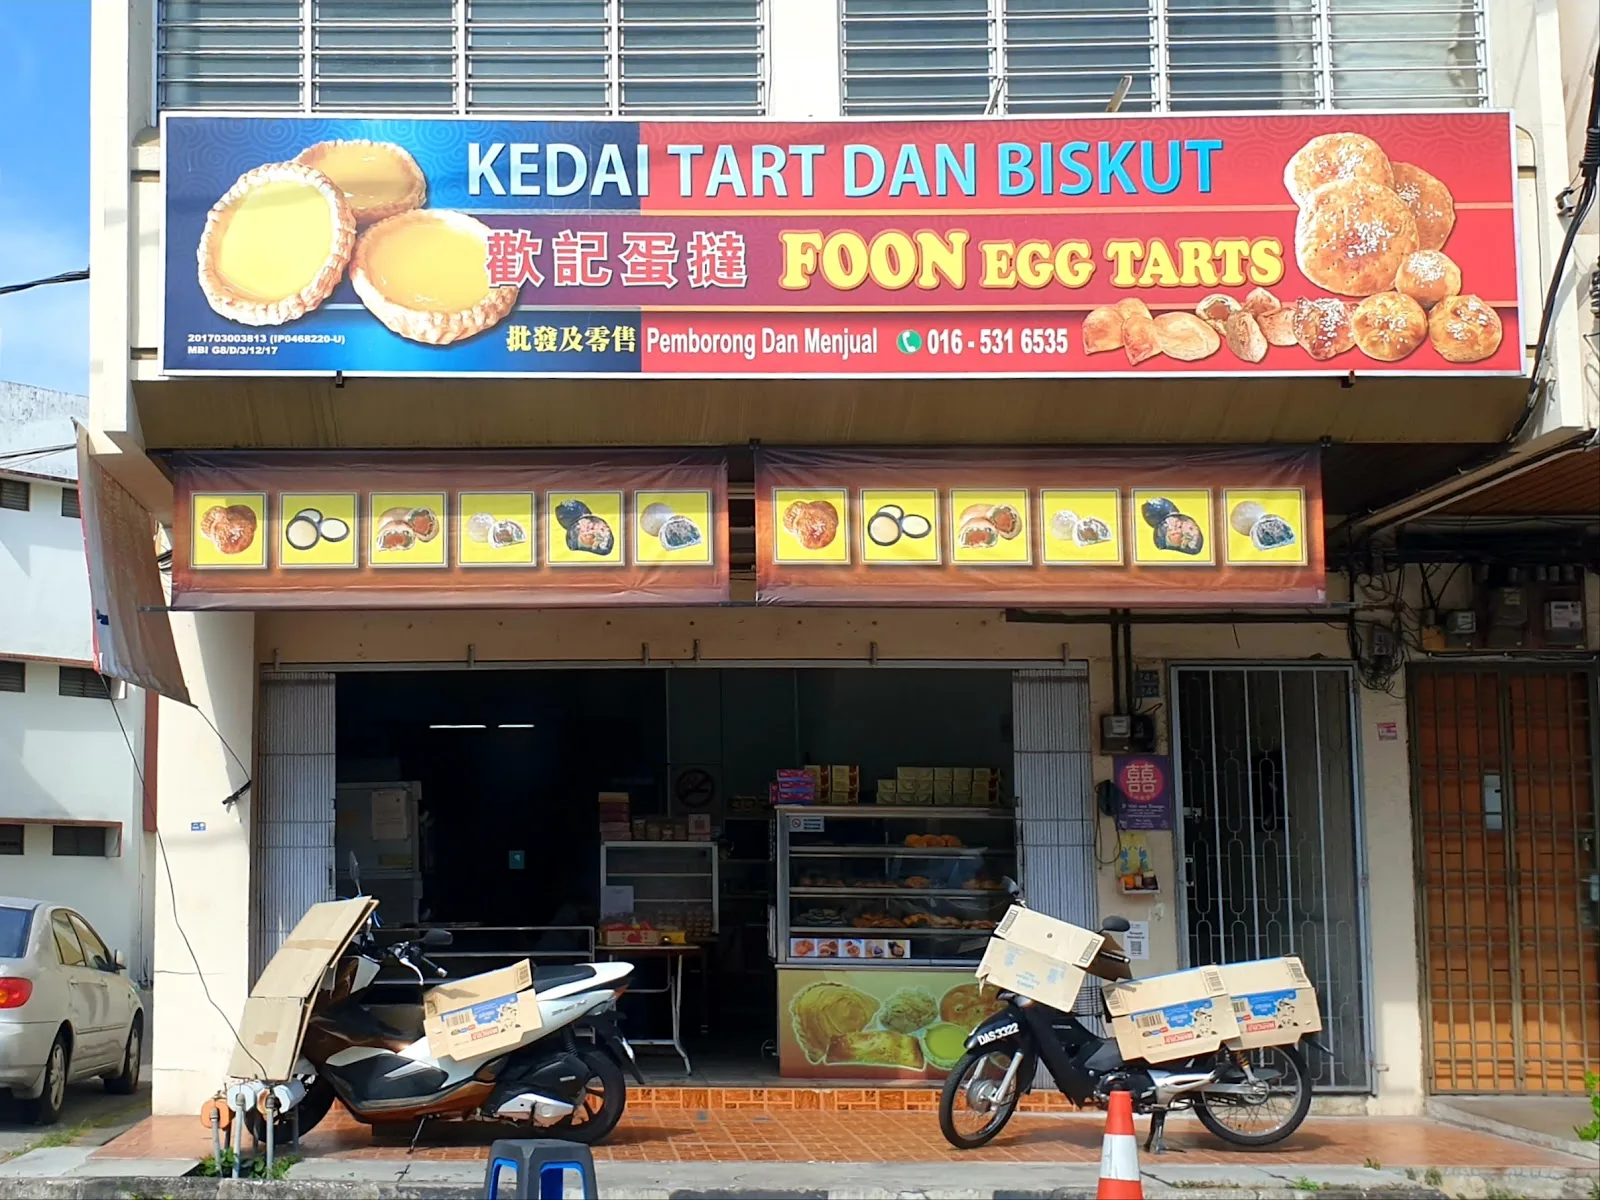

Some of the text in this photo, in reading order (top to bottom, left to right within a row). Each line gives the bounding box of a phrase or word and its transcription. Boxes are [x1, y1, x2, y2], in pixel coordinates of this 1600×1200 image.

[467, 138, 1223, 198] KEDAI TART DAN BISKUT
[485, 228, 748, 289] 歡記蛋撻
[778, 228, 1284, 290] FOON EGG TARTS
[187, 346, 209, 355] MBI
[505, 325, 637, 353] 批發及零售
[646, 326, 879, 360] Pemborong Dan Menjual
[926, 328, 963, 355] 016
[979, 328, 1015, 355] 531
[1020, 328, 1069, 355] 6535
[976, 1022, 1020, 1046] DAS3322
